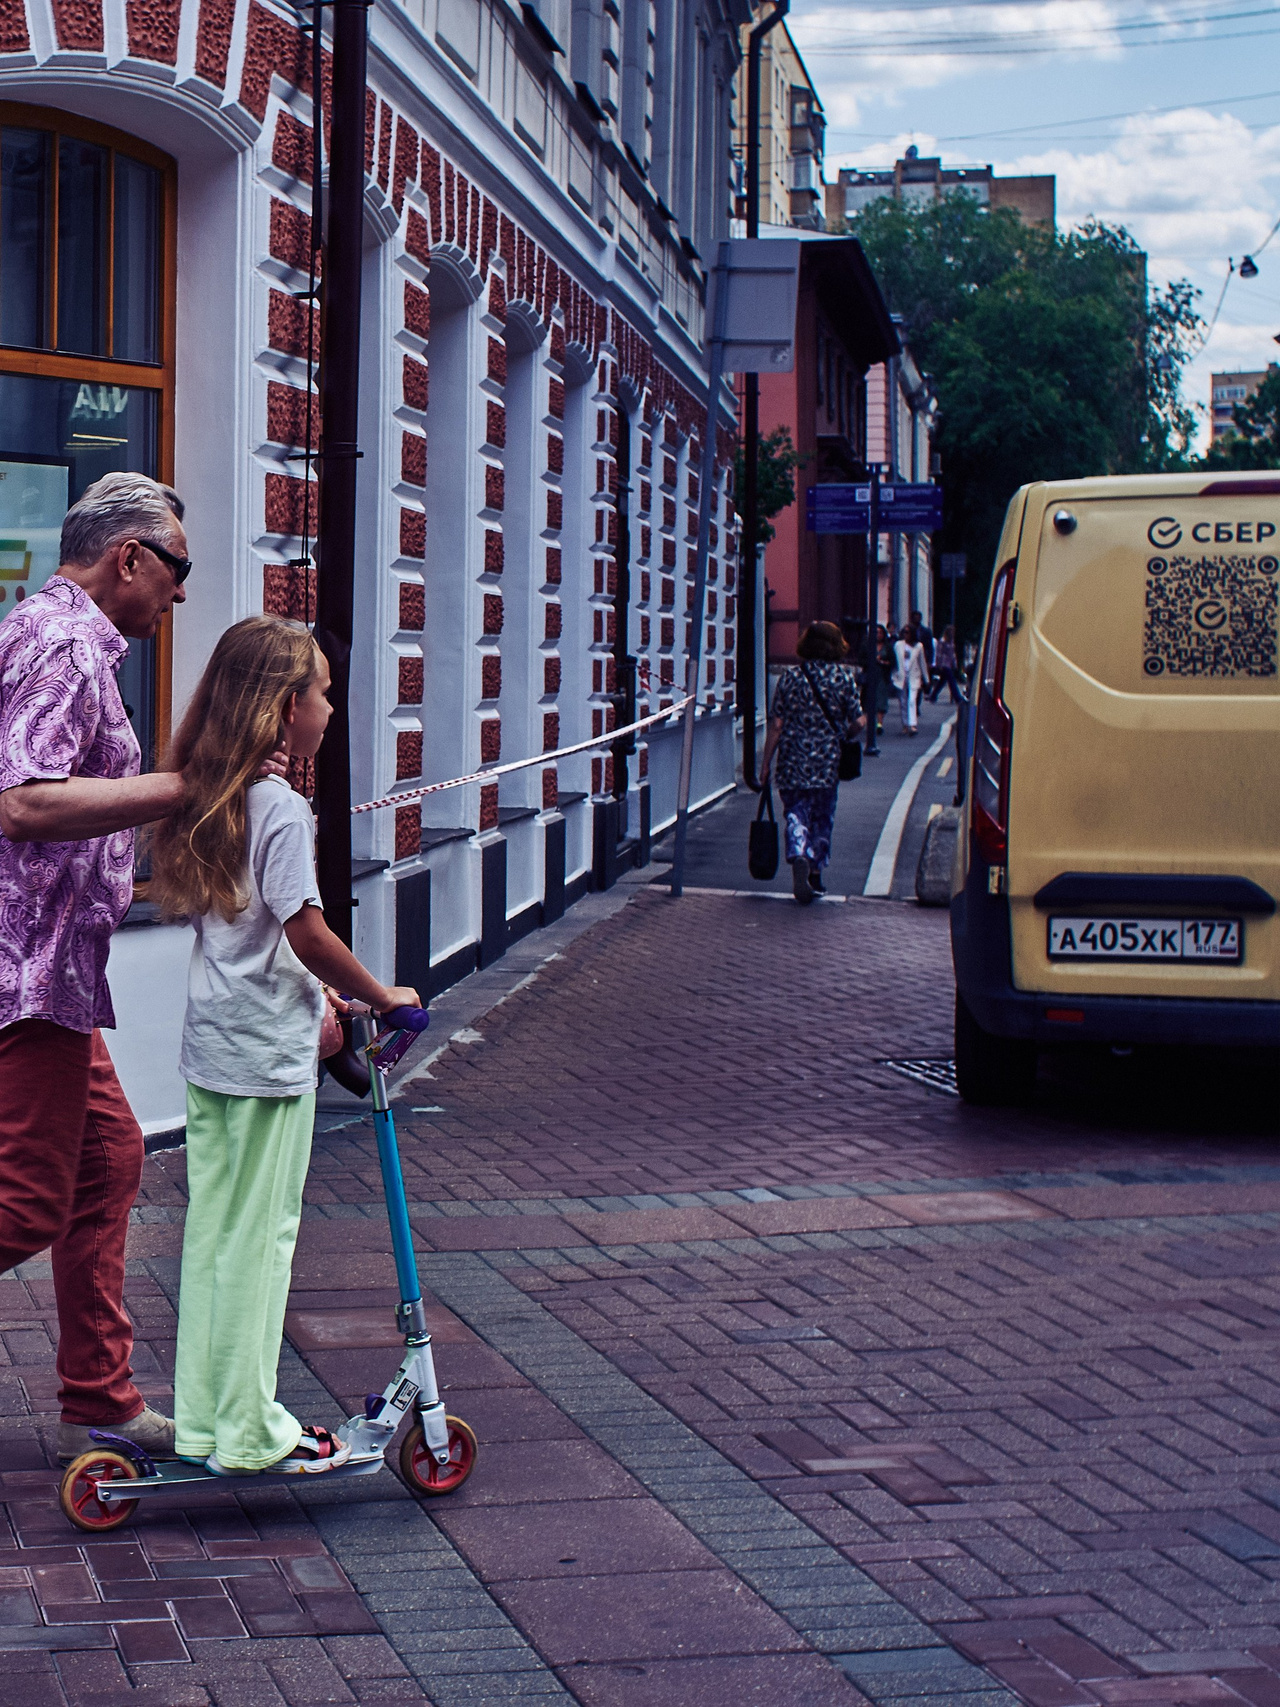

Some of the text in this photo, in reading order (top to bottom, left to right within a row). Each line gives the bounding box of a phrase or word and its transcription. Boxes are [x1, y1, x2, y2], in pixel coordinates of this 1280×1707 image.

[1191, 522, 1277, 543] СБЕР
[1186, 922, 1233, 945] 177
[1196, 944, 1218, 954] RUS
